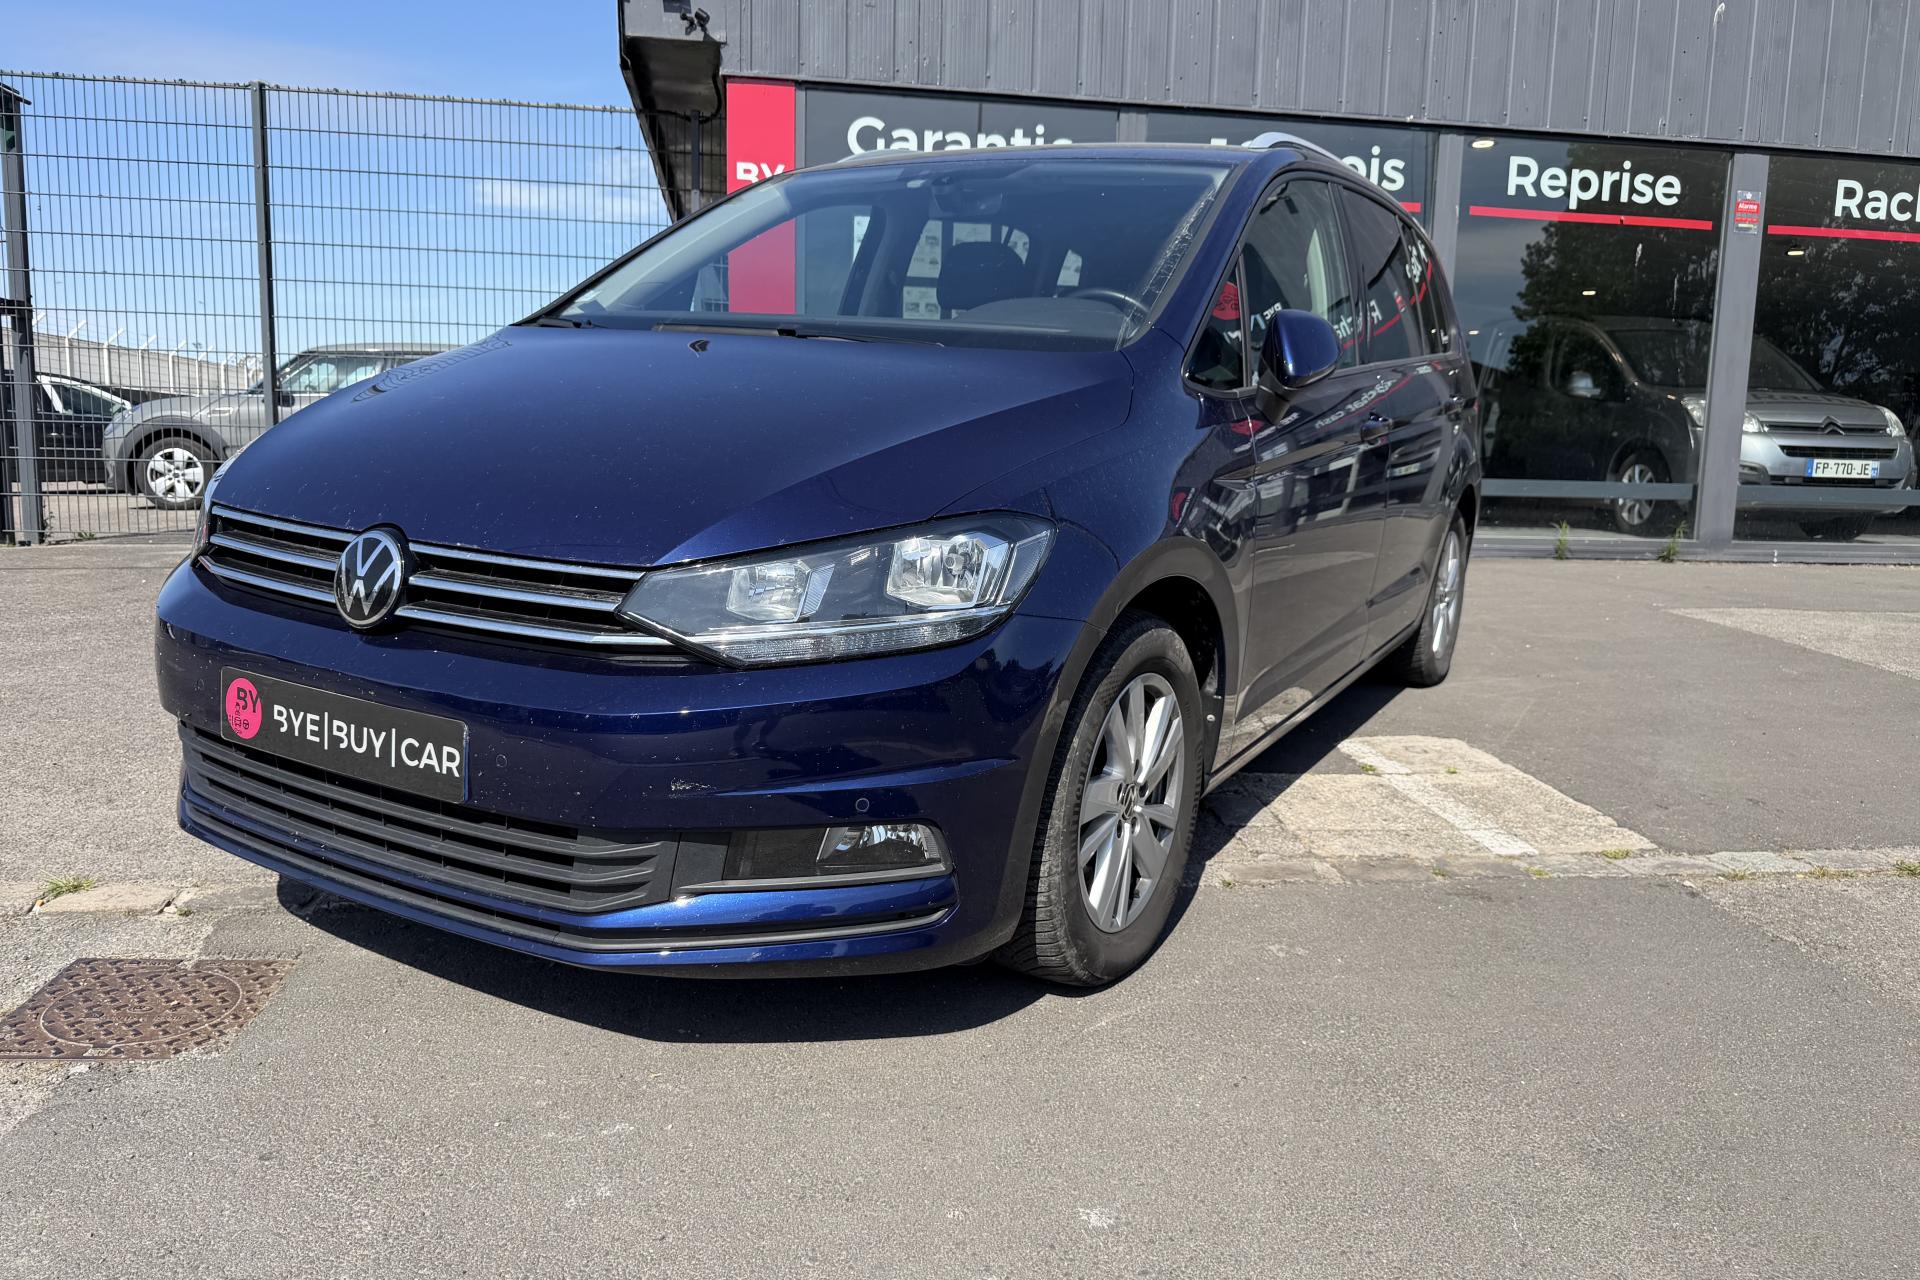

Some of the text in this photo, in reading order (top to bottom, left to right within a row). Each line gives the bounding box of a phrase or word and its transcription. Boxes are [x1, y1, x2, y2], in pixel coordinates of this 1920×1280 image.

[847, 116, 1073, 154] Garanti
[1507, 155, 1682, 209] Reprise
[1834, 178, 1920, 223] Rac
[1815, 462, 1870, 476] FP-770-JE
